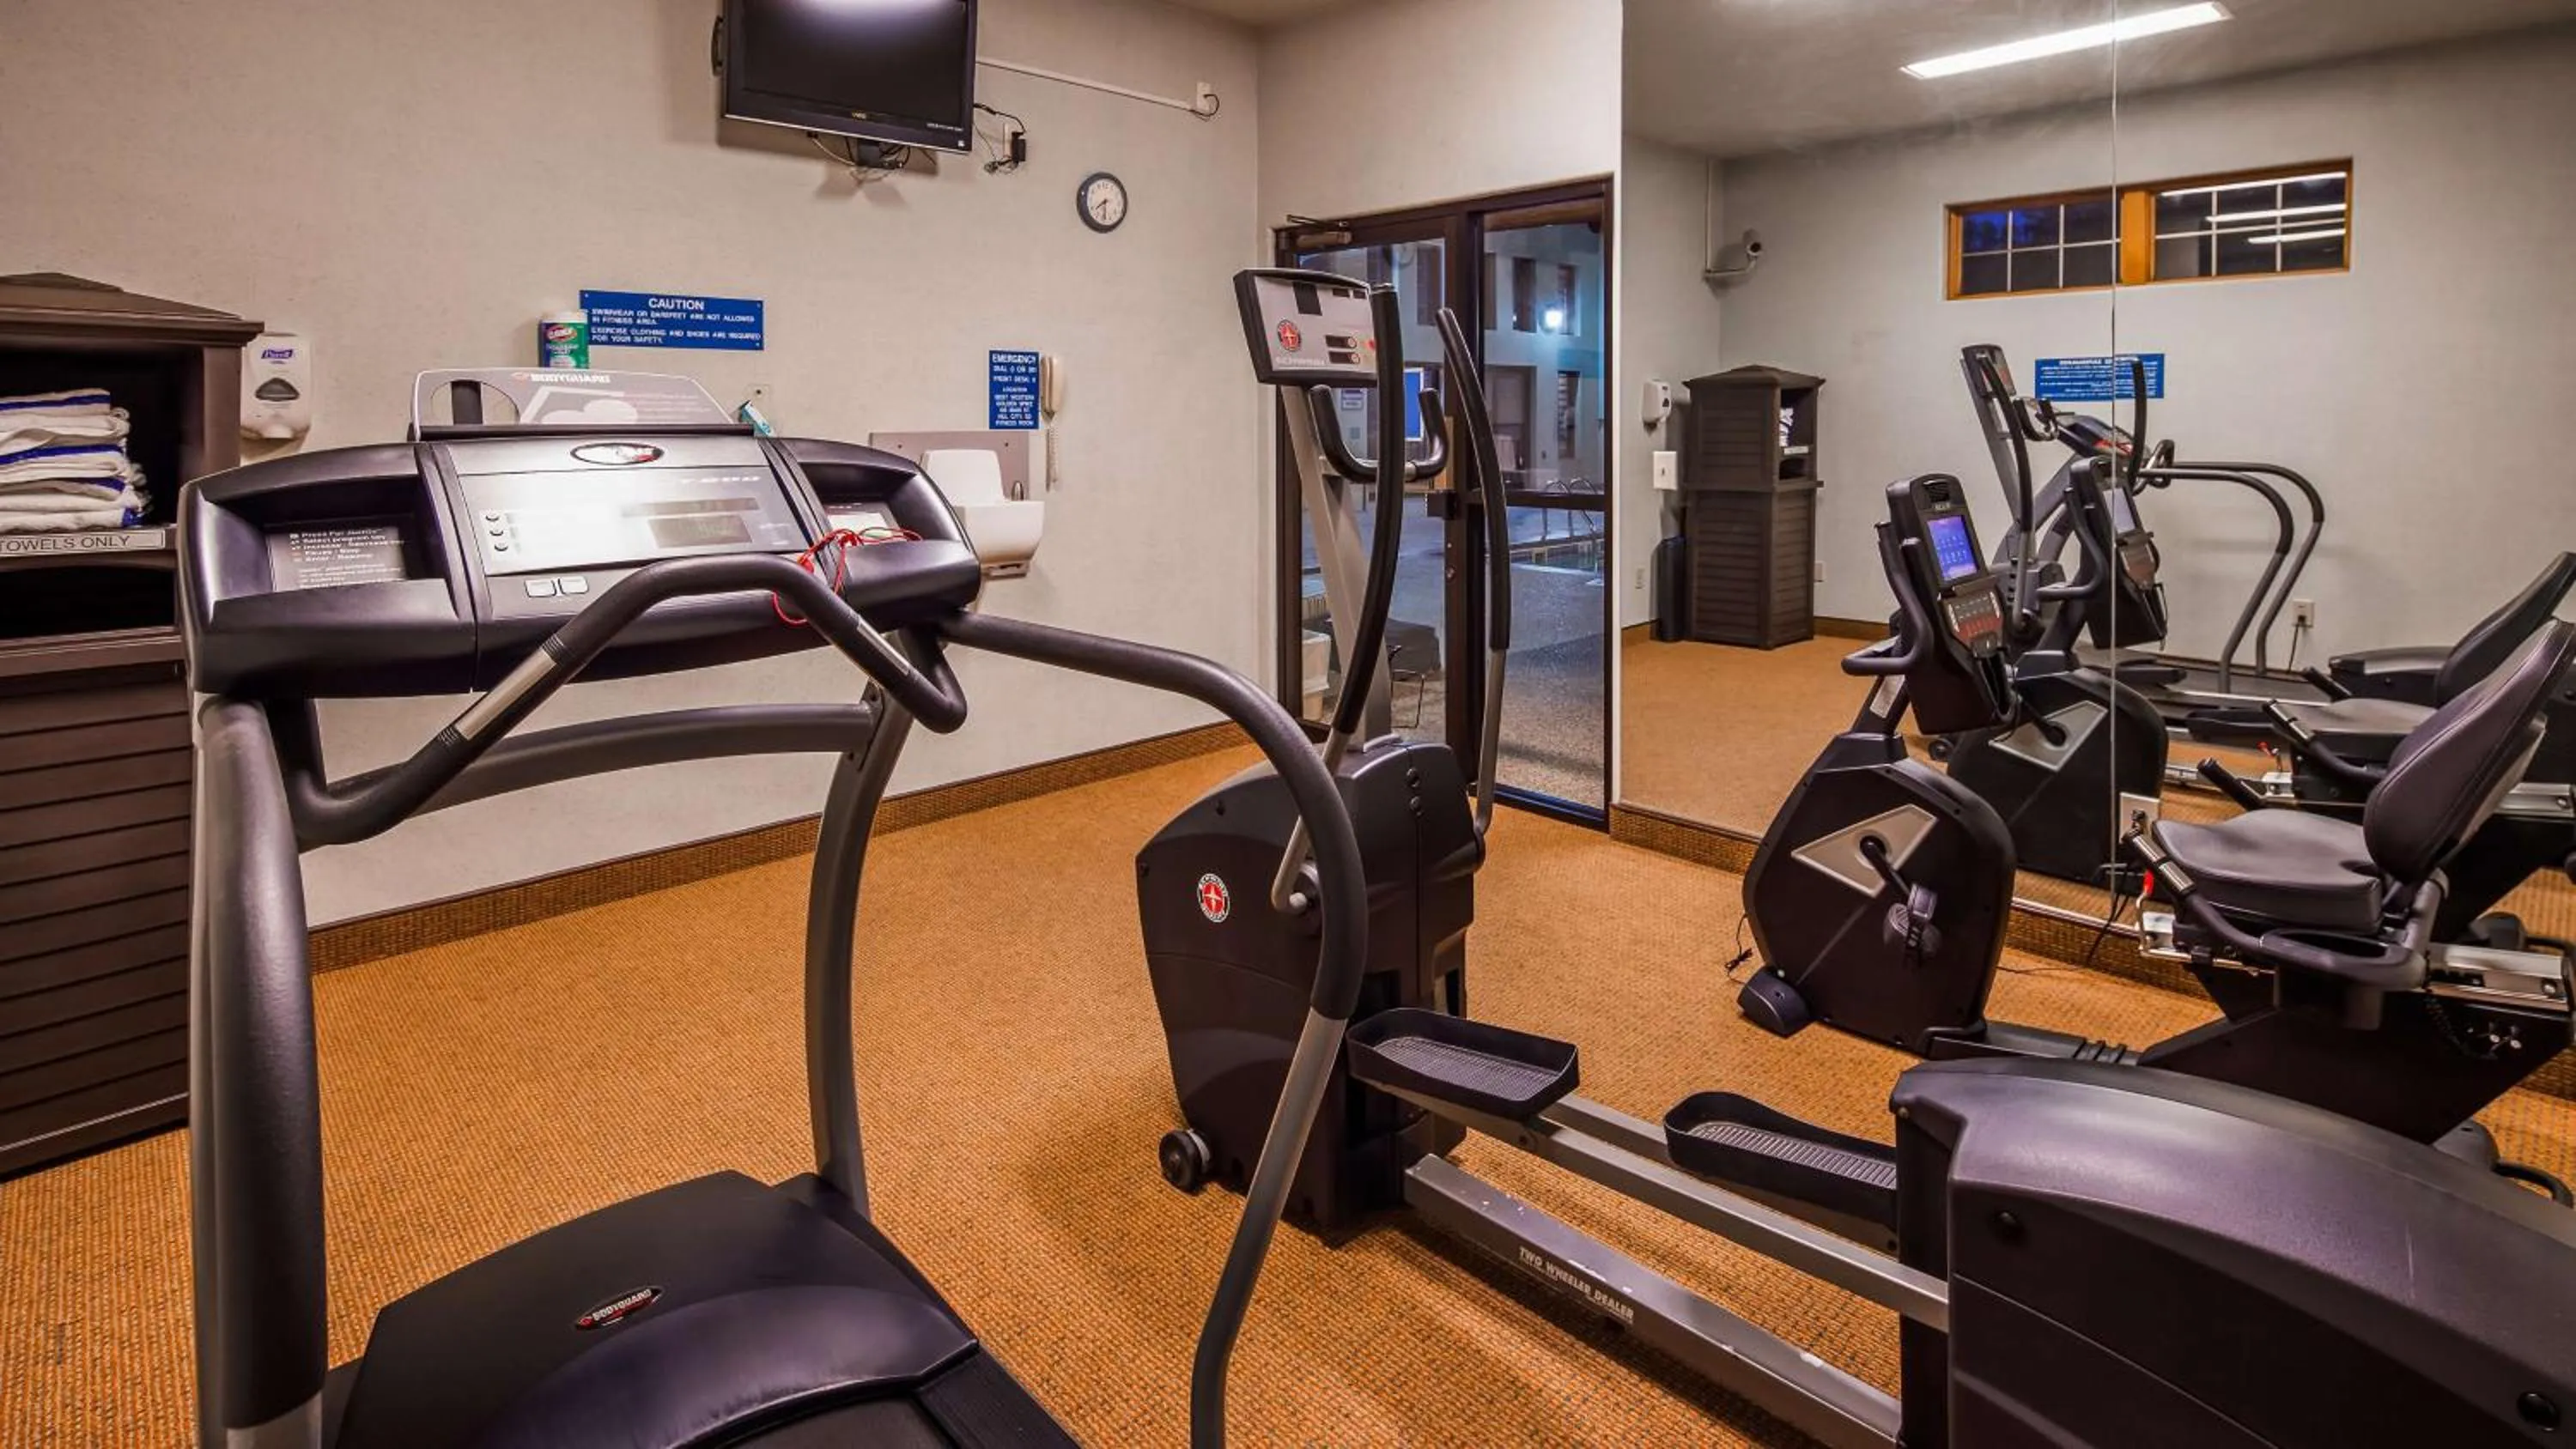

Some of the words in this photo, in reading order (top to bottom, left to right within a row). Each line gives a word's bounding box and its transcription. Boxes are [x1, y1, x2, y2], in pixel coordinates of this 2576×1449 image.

[648, 298, 704, 310] CAUTION
[723, 314, 755, 323] ALLOWED
[992, 353, 1036, 365] EMERGENCY
[81, 535, 131, 549] ONLY
[1519, 1246, 1543, 1266] TWO
[1546, 1261, 1591, 1295] WHEELER
[1594, 1289, 1634, 1320] DEALER
[592, 1288, 652, 1321] BODYGUARD
